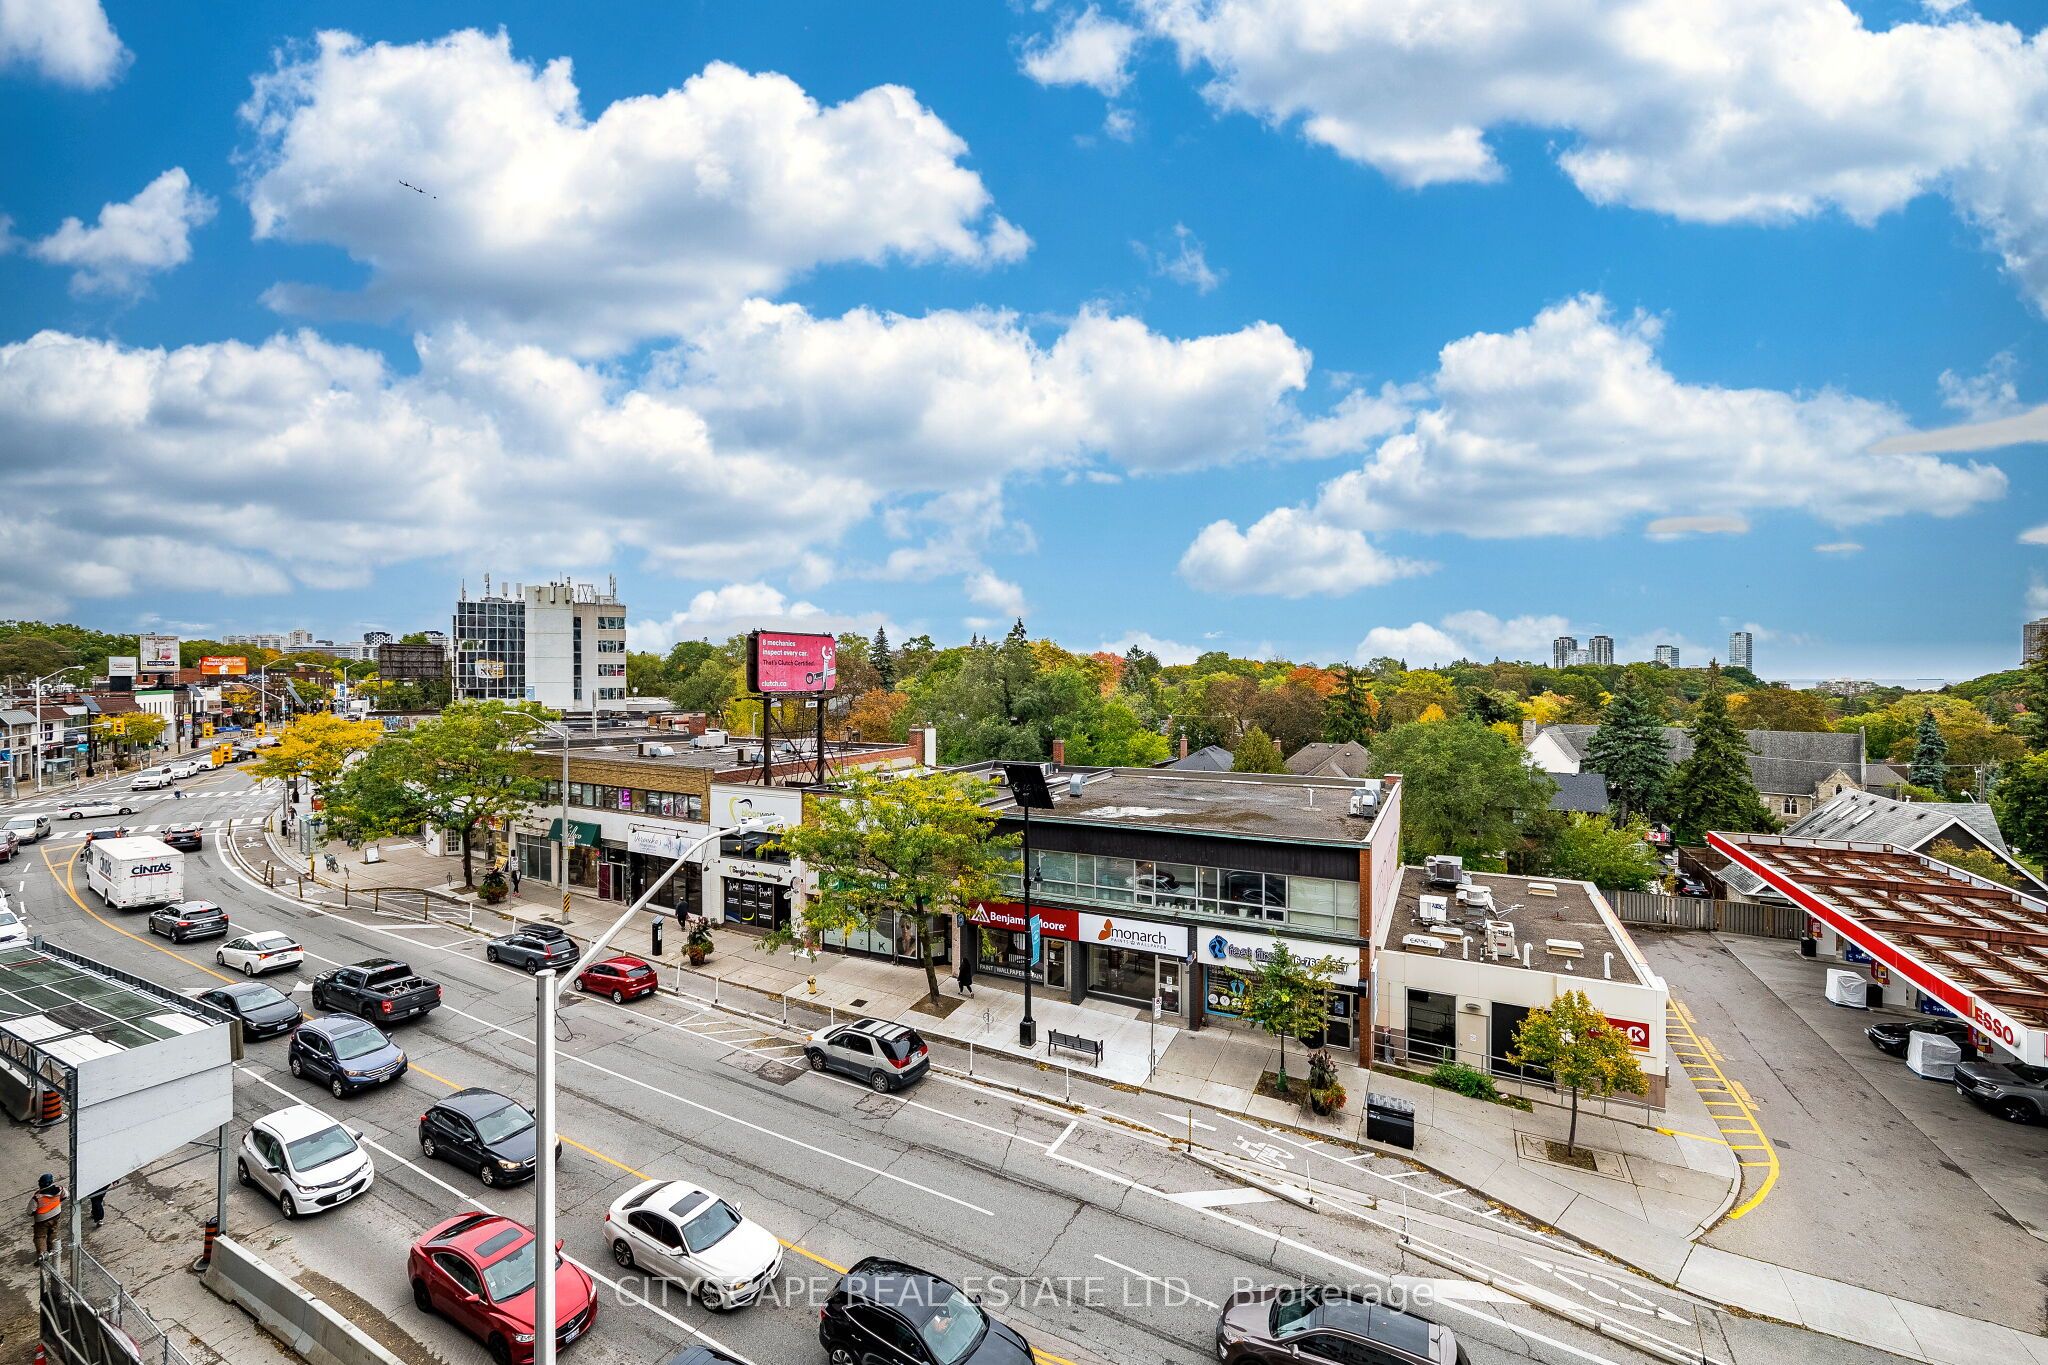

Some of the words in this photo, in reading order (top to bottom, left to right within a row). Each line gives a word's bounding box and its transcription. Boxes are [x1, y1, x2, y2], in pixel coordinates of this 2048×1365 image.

[762, 648, 782, 656] inspect
[990, 911, 1025, 926] Benjami
[1111, 928, 1167, 945] monarch
[878, 941, 887, 952] K
[1136, 941, 1167, 949] WALLPAPER
[979, 964, 994, 972] PAINT
[1974, 1005, 2014, 1046] ESSO
[1631, 1028, 1644, 1042] K
